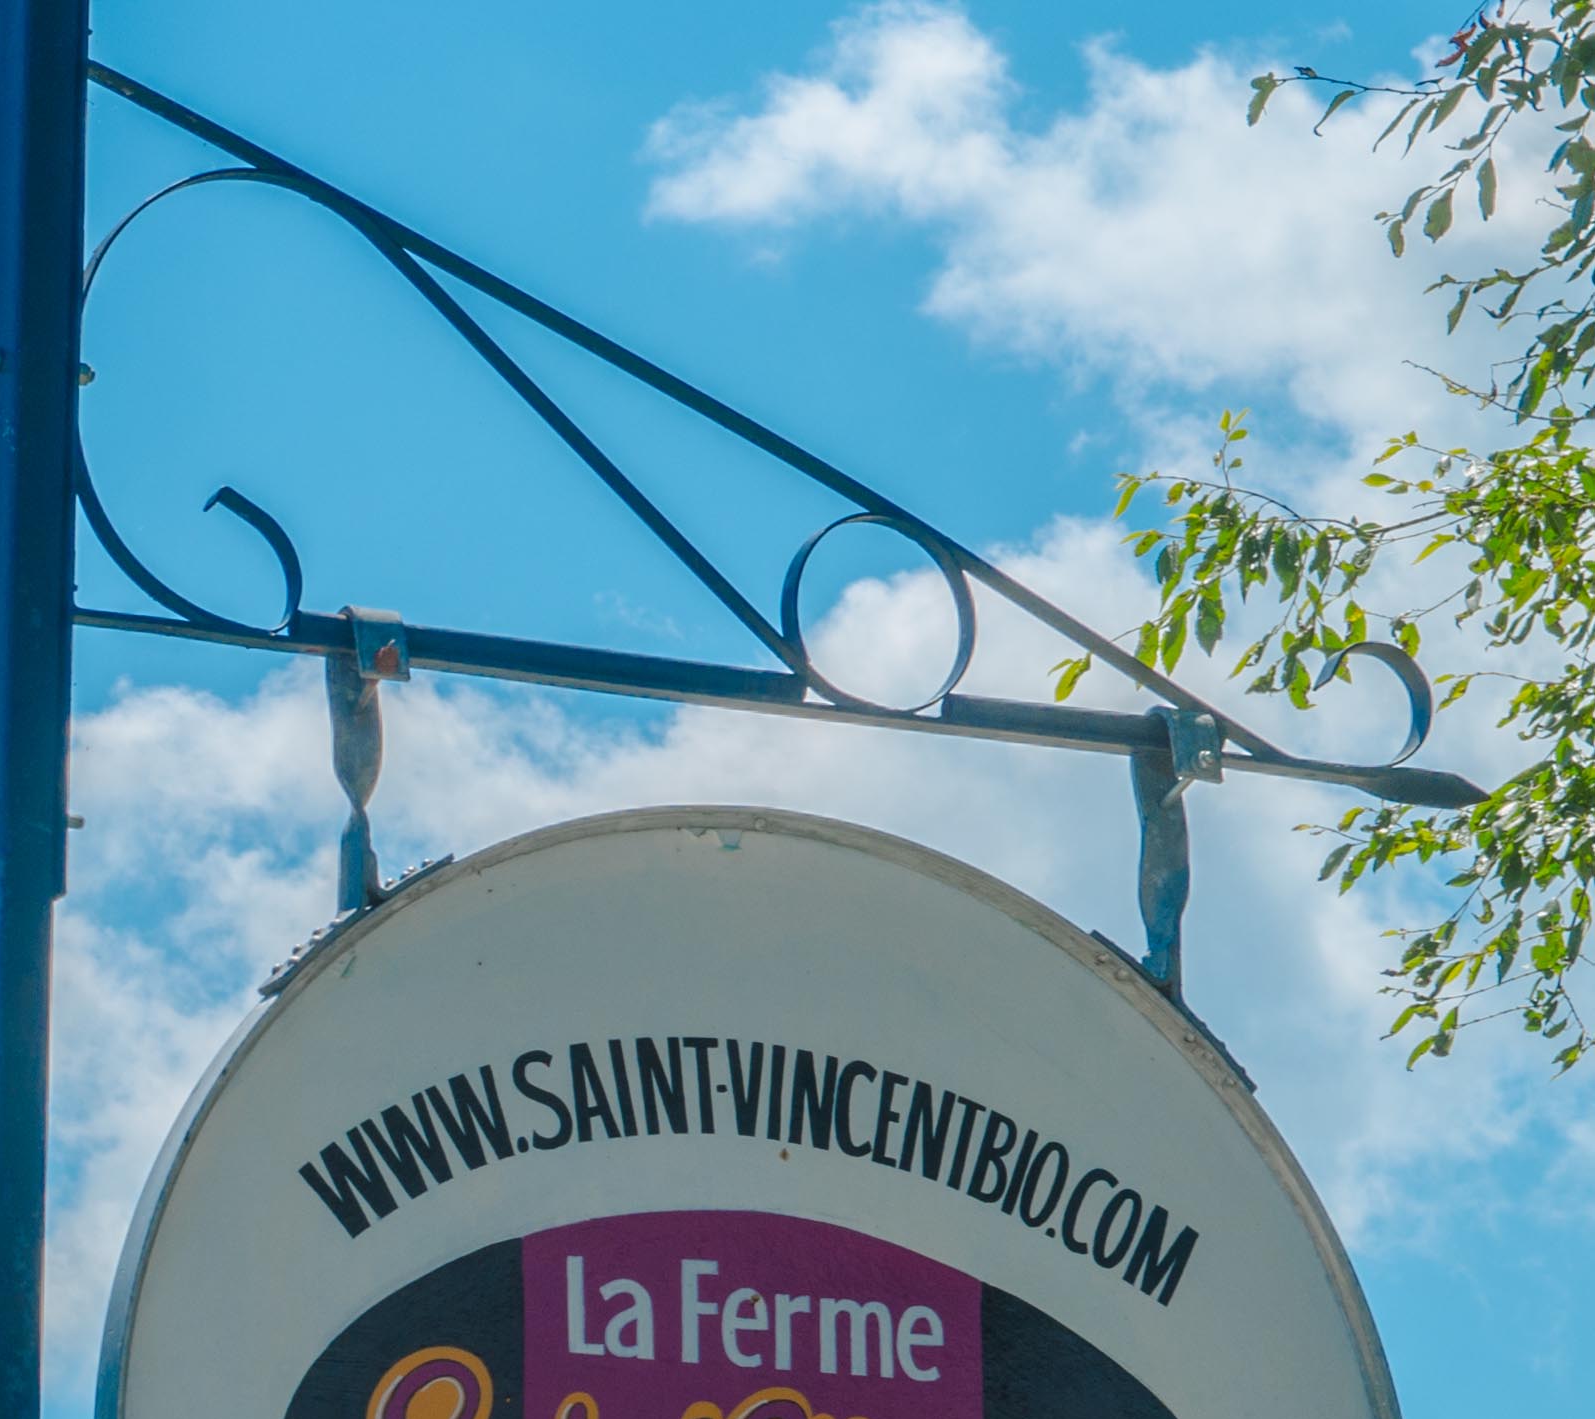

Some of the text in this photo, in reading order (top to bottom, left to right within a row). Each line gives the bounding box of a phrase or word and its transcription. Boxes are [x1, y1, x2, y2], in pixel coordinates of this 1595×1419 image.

[298, 1037, 1200, 1306] WWW.SAINT-VINCENTBIO.COM
[565, 1255, 945, 1382] La Ferme
